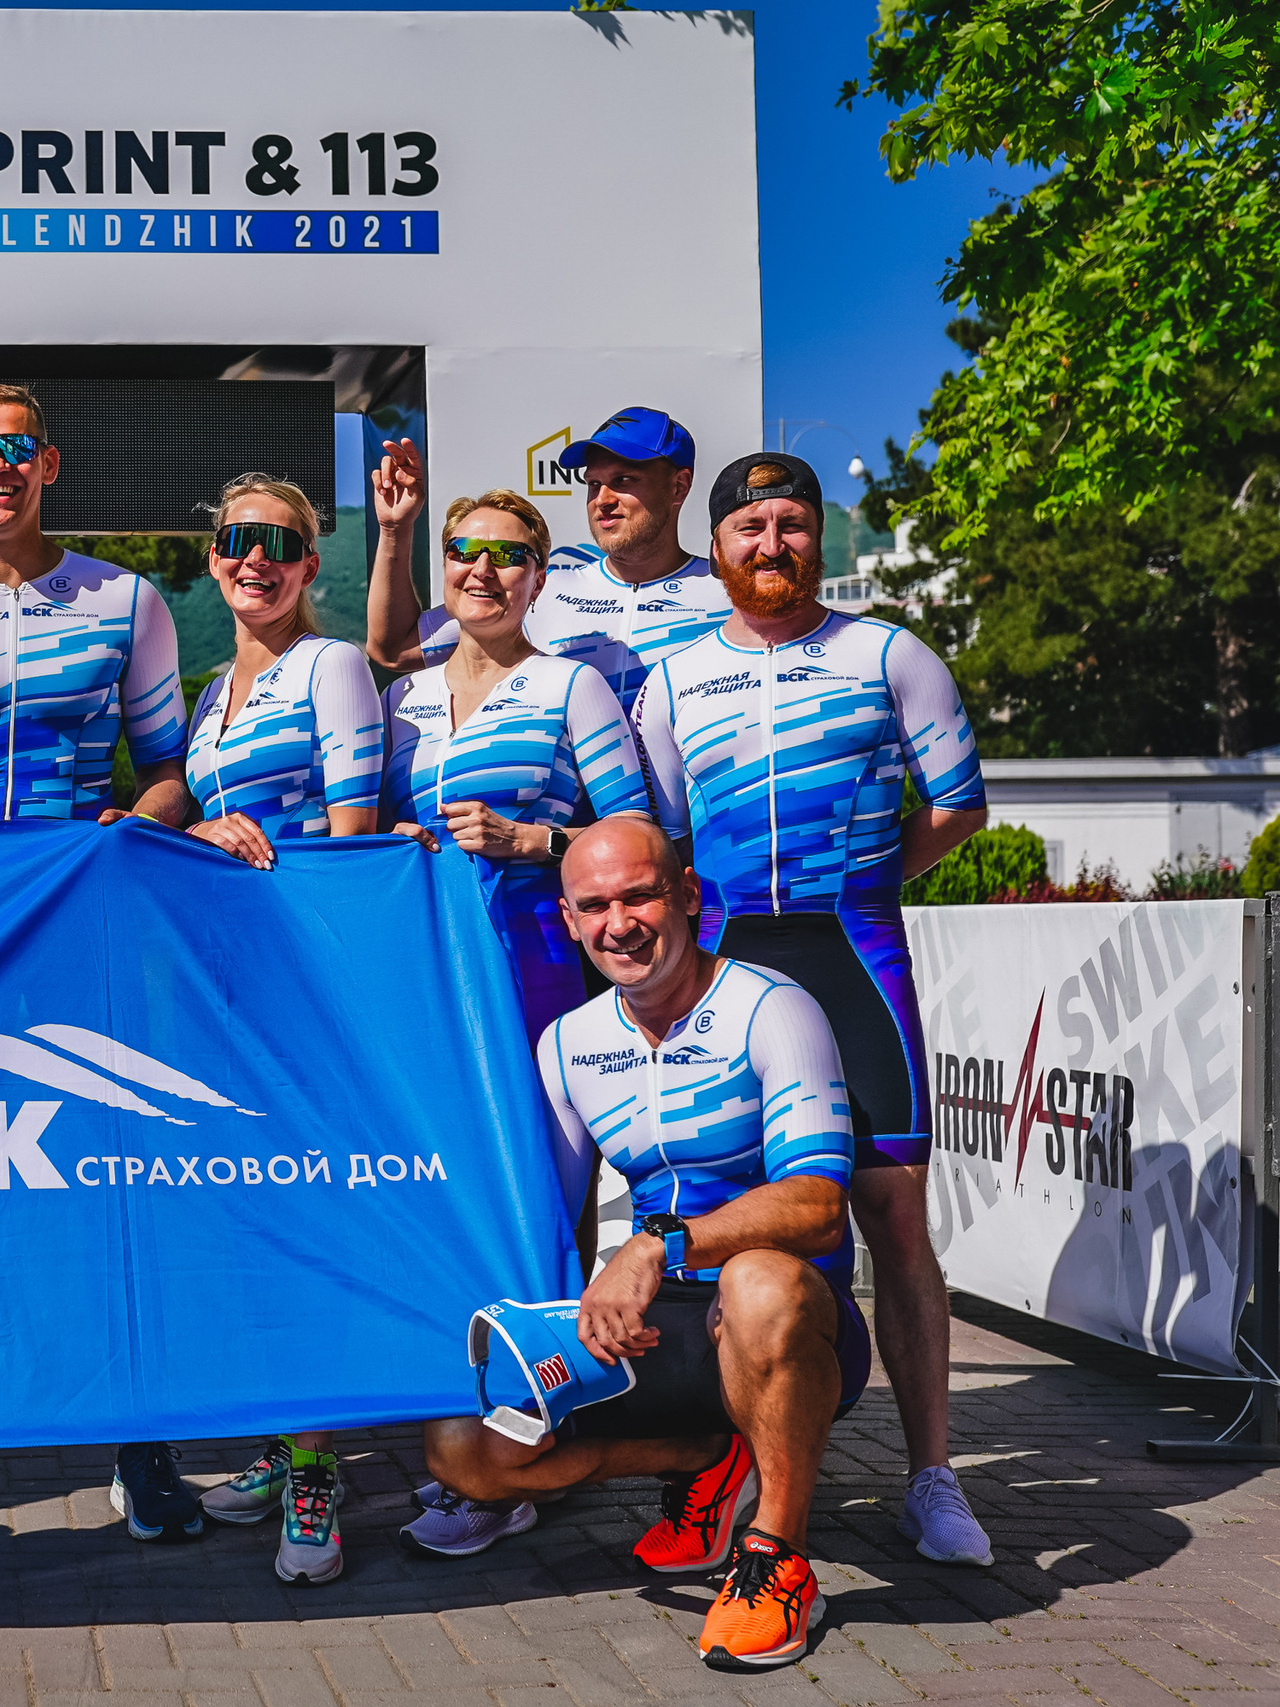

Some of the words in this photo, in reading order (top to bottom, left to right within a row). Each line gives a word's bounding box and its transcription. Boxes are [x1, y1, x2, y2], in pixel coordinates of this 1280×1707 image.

[245, 133, 301, 197] &
[319, 130, 439, 197] 113
[293, 214, 412, 248] 2021
[555, 593, 618, 607] НАДЕЖНАЯ
[637, 603, 665, 613] ВСК
[22, 607, 53, 618] ВСК
[575, 605, 624, 614] ЗАЩИТА
[678, 671, 750, 700] НАДЕЖНАЯ
[777, 673, 809, 683] ВСК
[701, 679, 762, 698] ЗАЩИТА
[396, 704, 443, 715] НАДЕЖНАЯ
[412, 711, 447, 720] ЗАЩИТА
[482, 703, 505, 713] ВСК
[635, 685, 648, 728] TEAM
[635, 730, 659, 811] TRIATHLON
[571, 1048, 634, 1066] НАДЕЖНАЯ
[599, 1055, 647, 1075] ЗАЩИТА
[663, 1053, 692, 1065] ВСК
[935, 1052, 1004, 1163] IRON
[1045, 1067, 1134, 1192] STAR
[75, 1148, 333, 1188] СТРАХОВОЙ
[347, 1151, 448, 1189] ДОМ
[936, 1163, 1132, 1225] TRIATHLON
